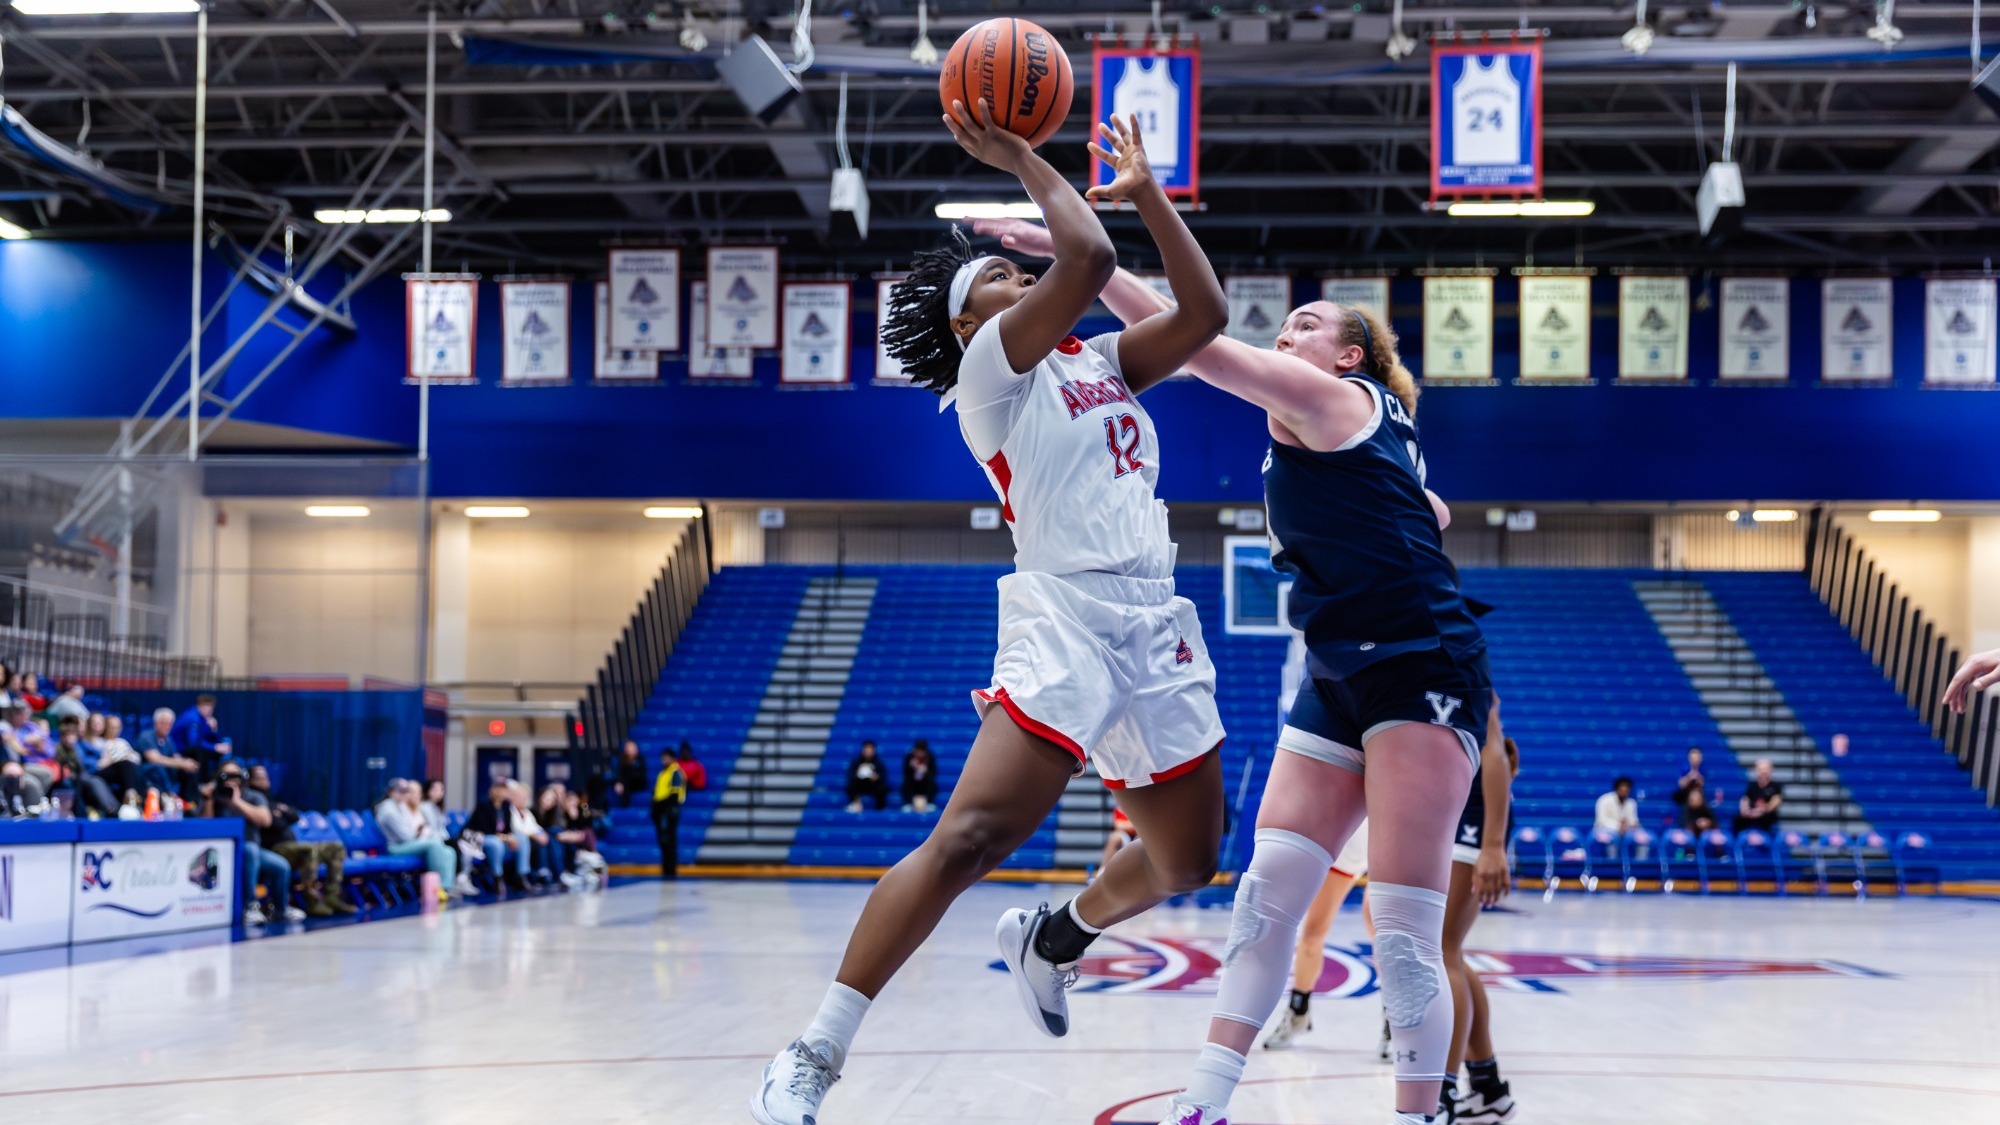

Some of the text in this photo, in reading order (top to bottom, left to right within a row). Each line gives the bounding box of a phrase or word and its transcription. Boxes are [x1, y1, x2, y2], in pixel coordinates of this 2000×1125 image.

[1018, 31, 1049, 117] Wilson
[1467, 106, 1503, 132] 24
[1104, 413, 1145, 479] 12
[1425, 691, 1462, 727] Y
[117, 849, 178, 893] Trails
